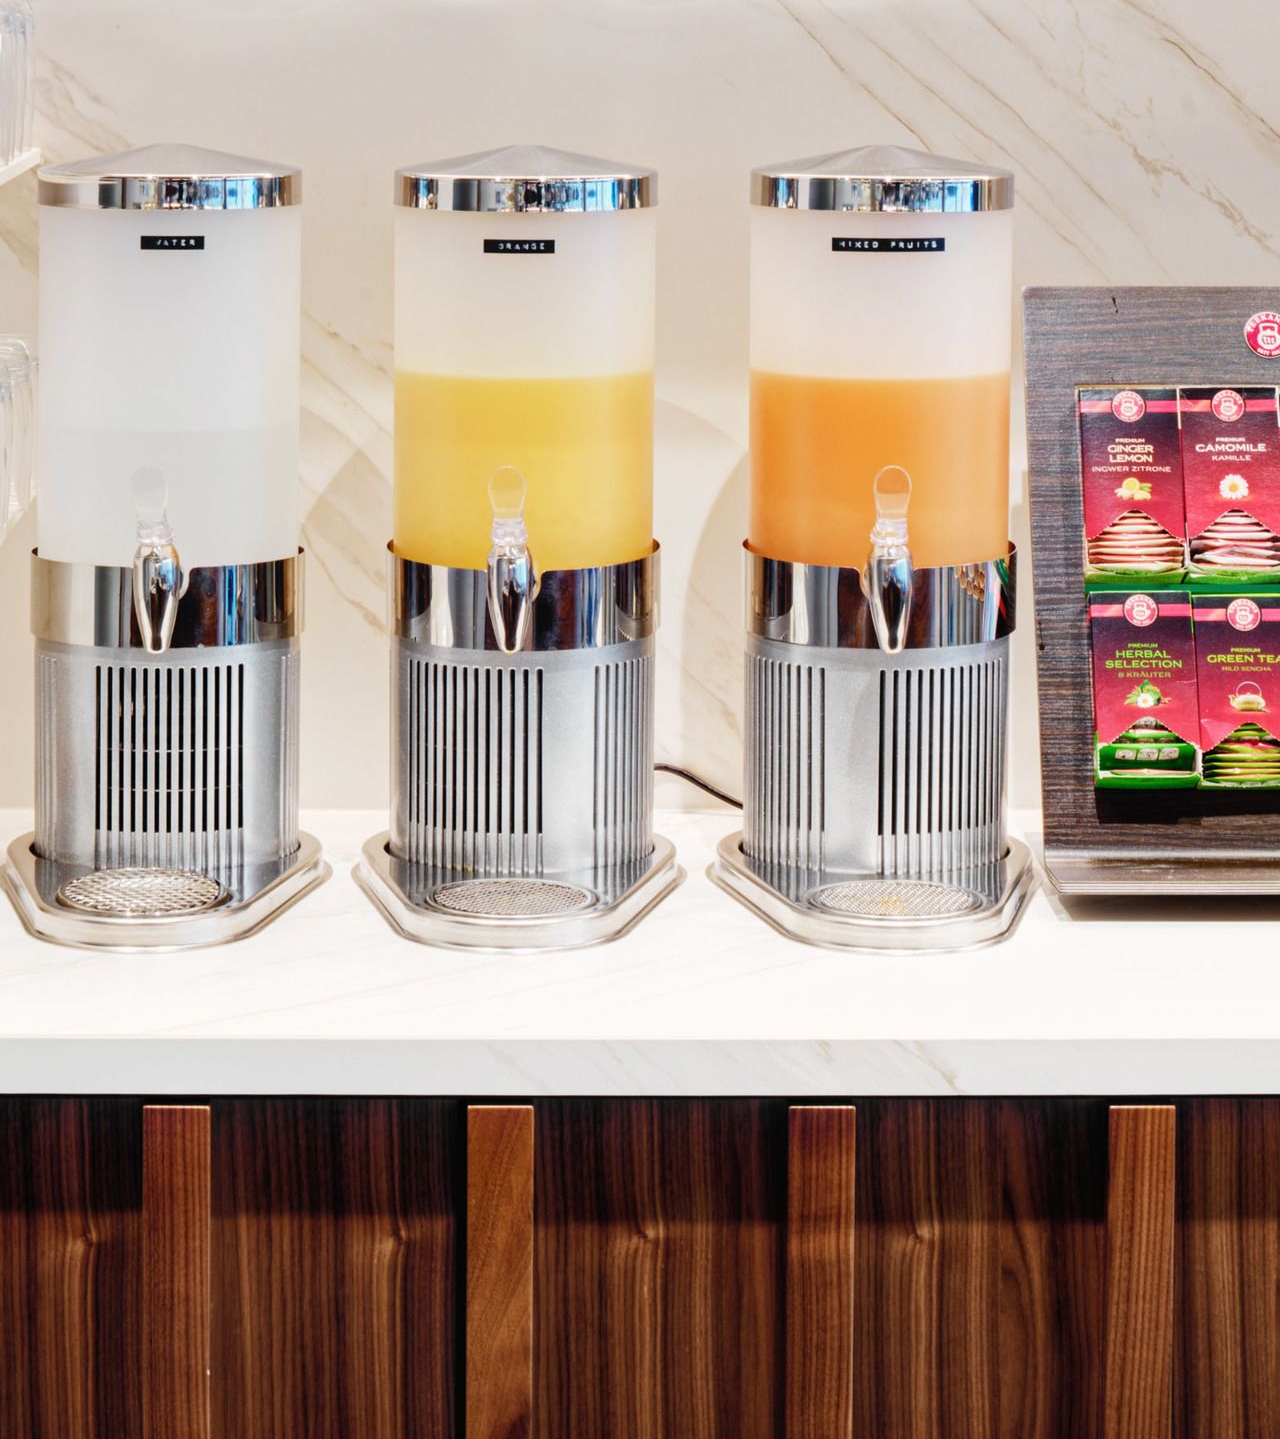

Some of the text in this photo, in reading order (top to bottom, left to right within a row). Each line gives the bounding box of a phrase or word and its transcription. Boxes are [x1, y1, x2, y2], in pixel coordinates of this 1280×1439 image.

[498, 242, 545, 251] ORANGE
[890, 240, 938, 249] FRUITS
[1107, 444, 1154, 454] GINGER
[1195, 443, 1267, 453] CAMOMILE
[1109, 454, 1153, 463] LEMON
[1092, 465, 1172, 473] INGWER ZITRONE
[1115, 650, 1172, 659] HERBAL
[1206, 654, 1254, 663] GREEN
[1105, 660, 1183, 669] SELECTION
